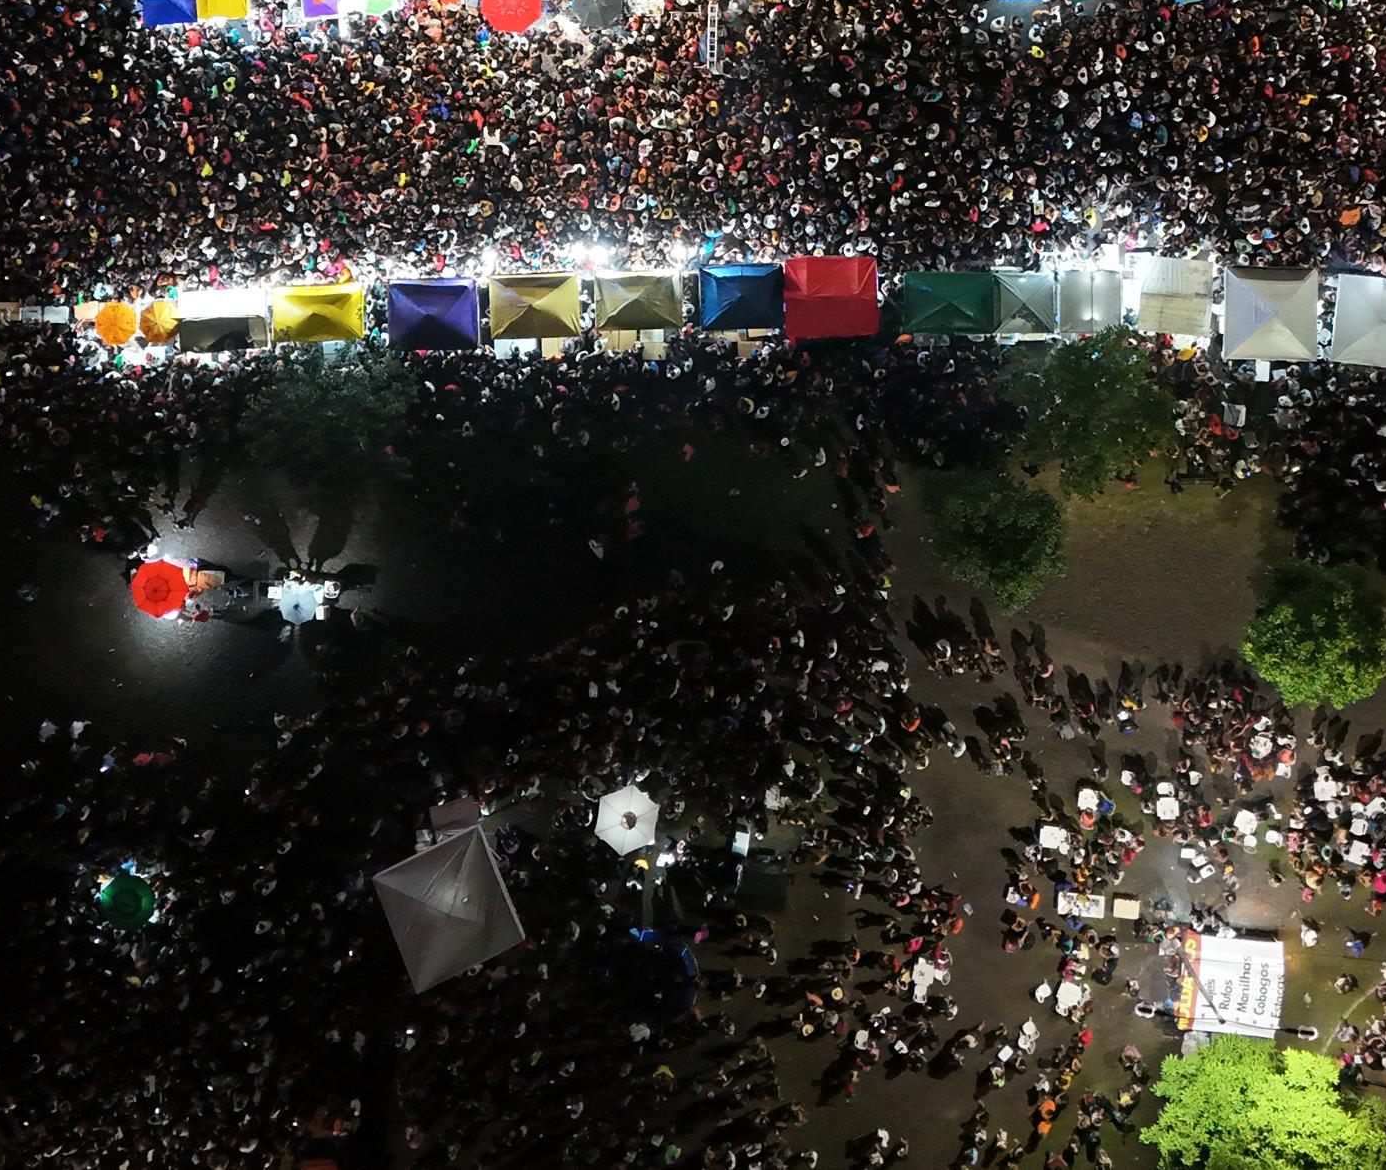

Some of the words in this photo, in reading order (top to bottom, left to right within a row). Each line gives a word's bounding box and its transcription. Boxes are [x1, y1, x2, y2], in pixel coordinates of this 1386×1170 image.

[1218, 979, 1233, 1010] Rufos
[1236, 955, 1252, 1013] Manilhas
[1254, 962, 1271, 1016] Cobogos
